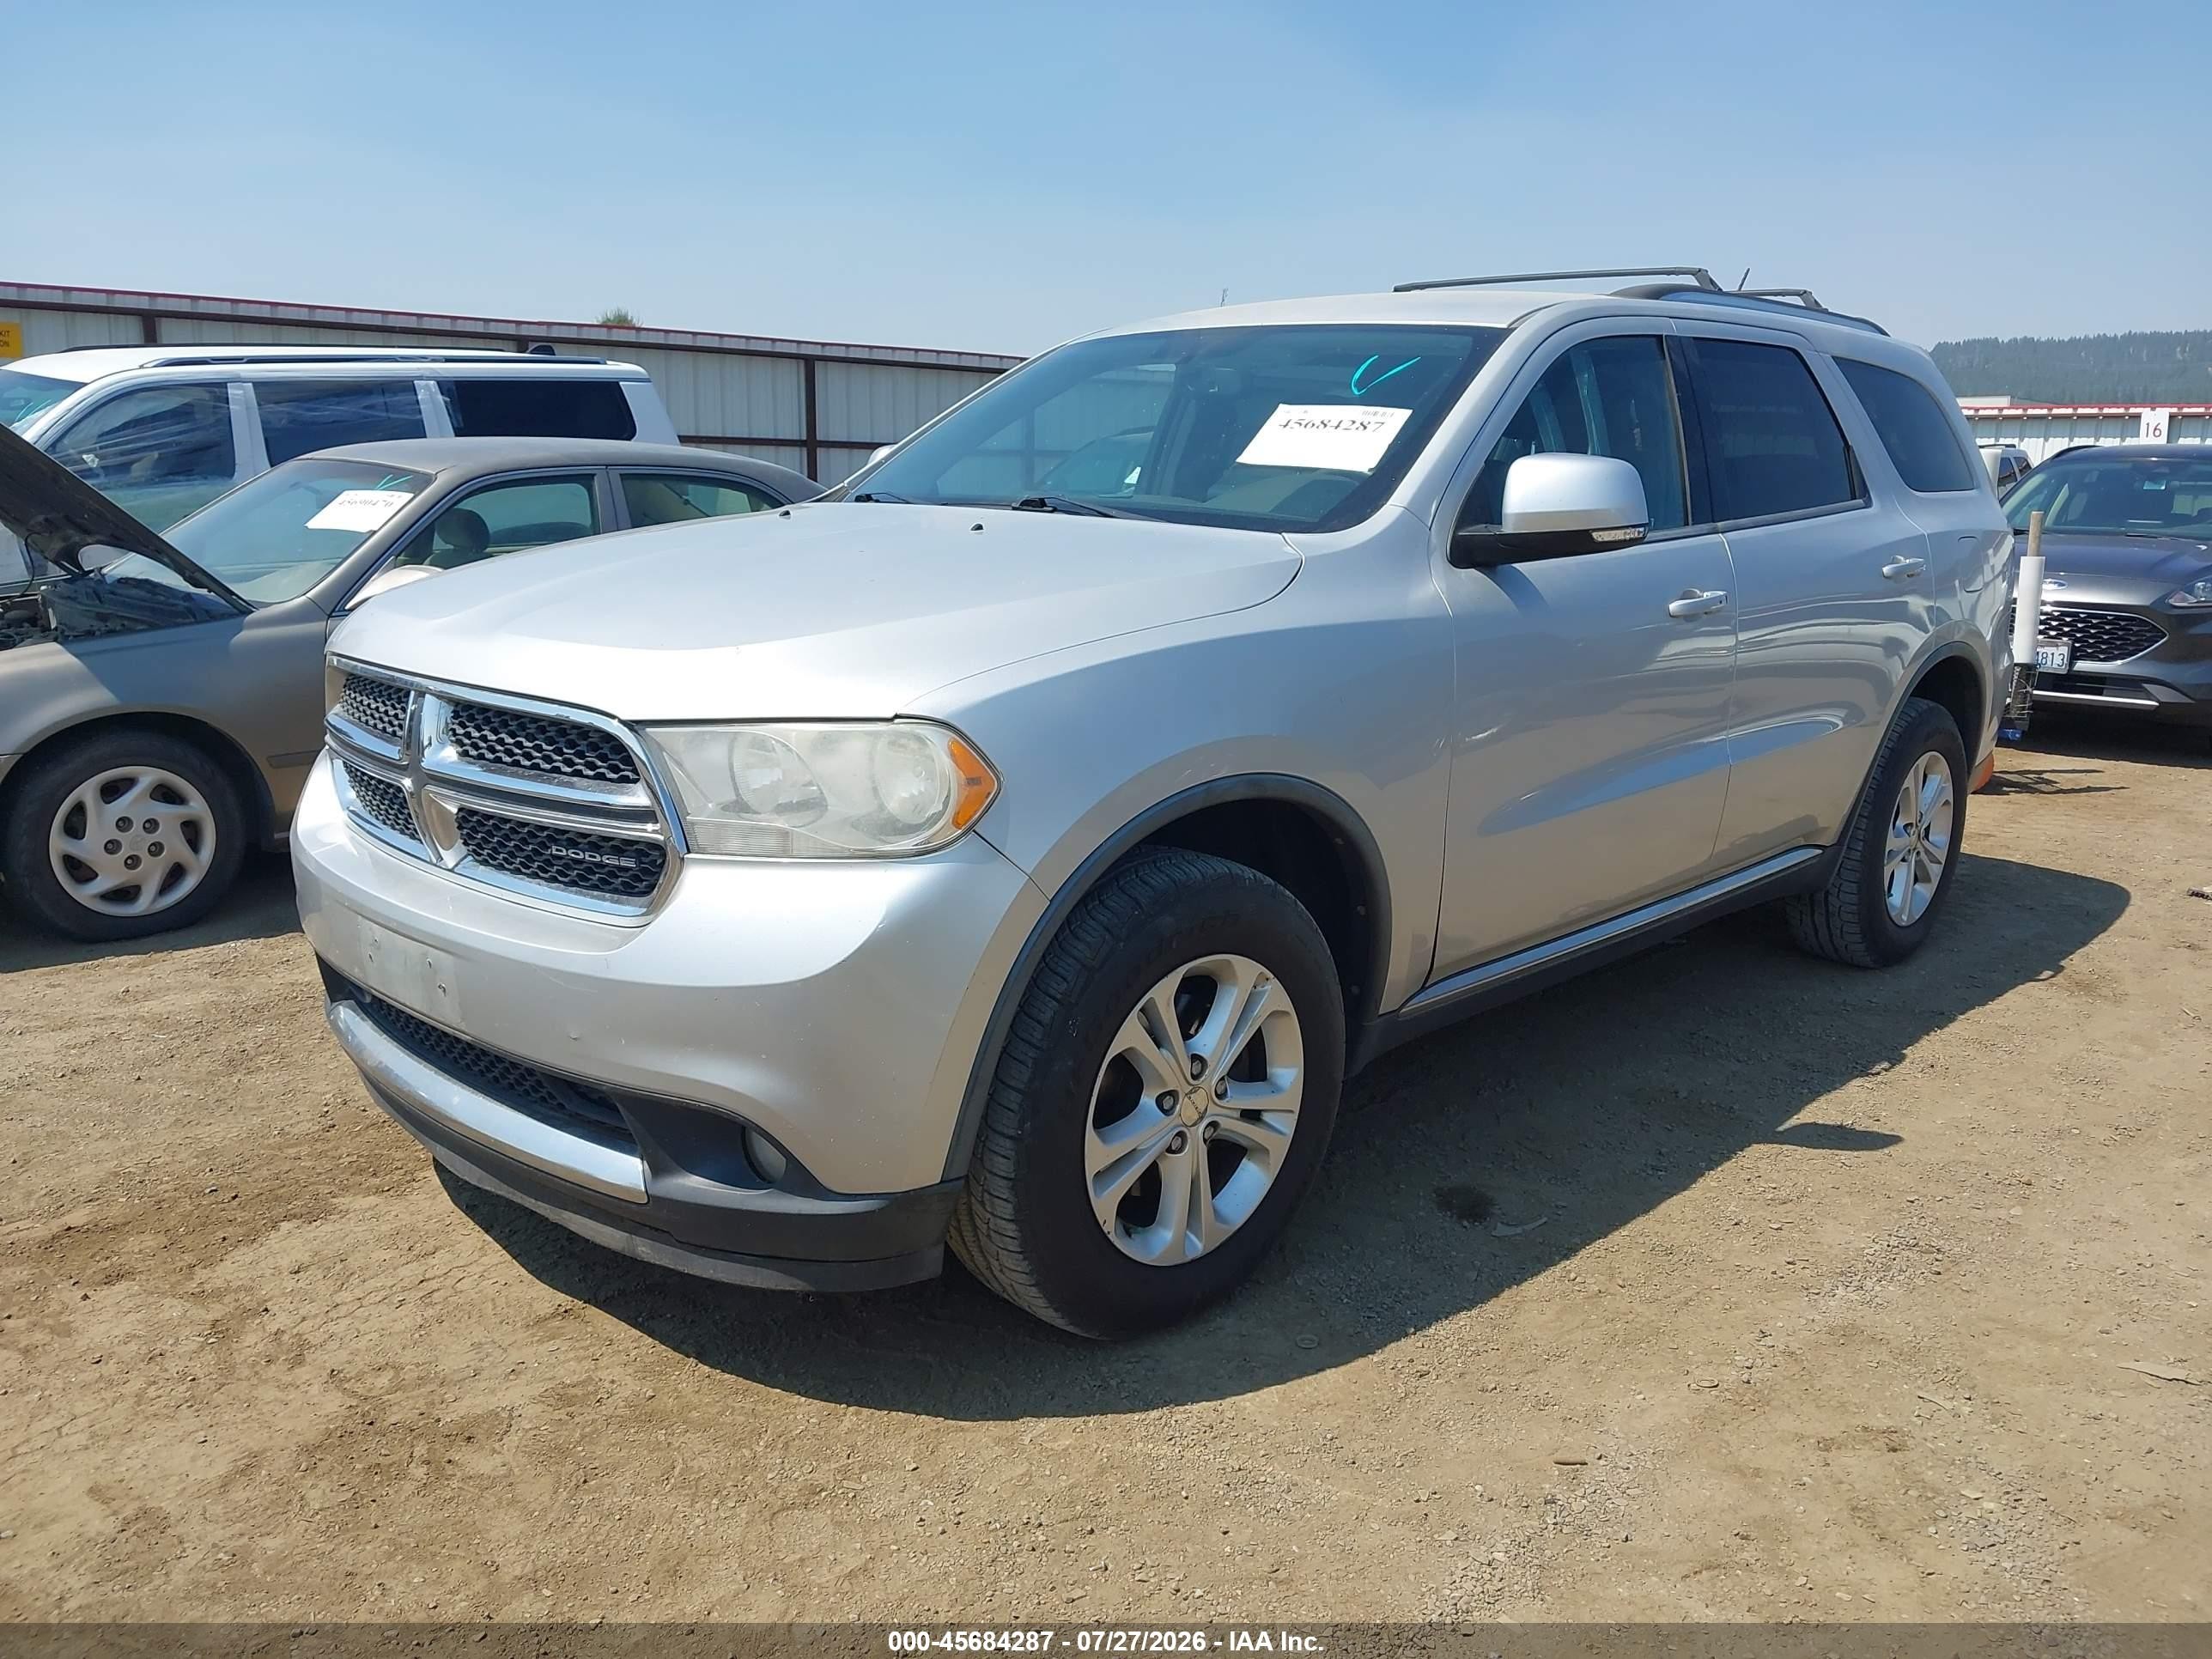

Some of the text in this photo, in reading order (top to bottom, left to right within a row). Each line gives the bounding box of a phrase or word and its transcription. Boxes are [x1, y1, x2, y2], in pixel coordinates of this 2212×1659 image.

[1279, 418, 1386, 433] 45684287
[2146, 422, 2162, 439] 16
[551, 845, 636, 868] DODGE
